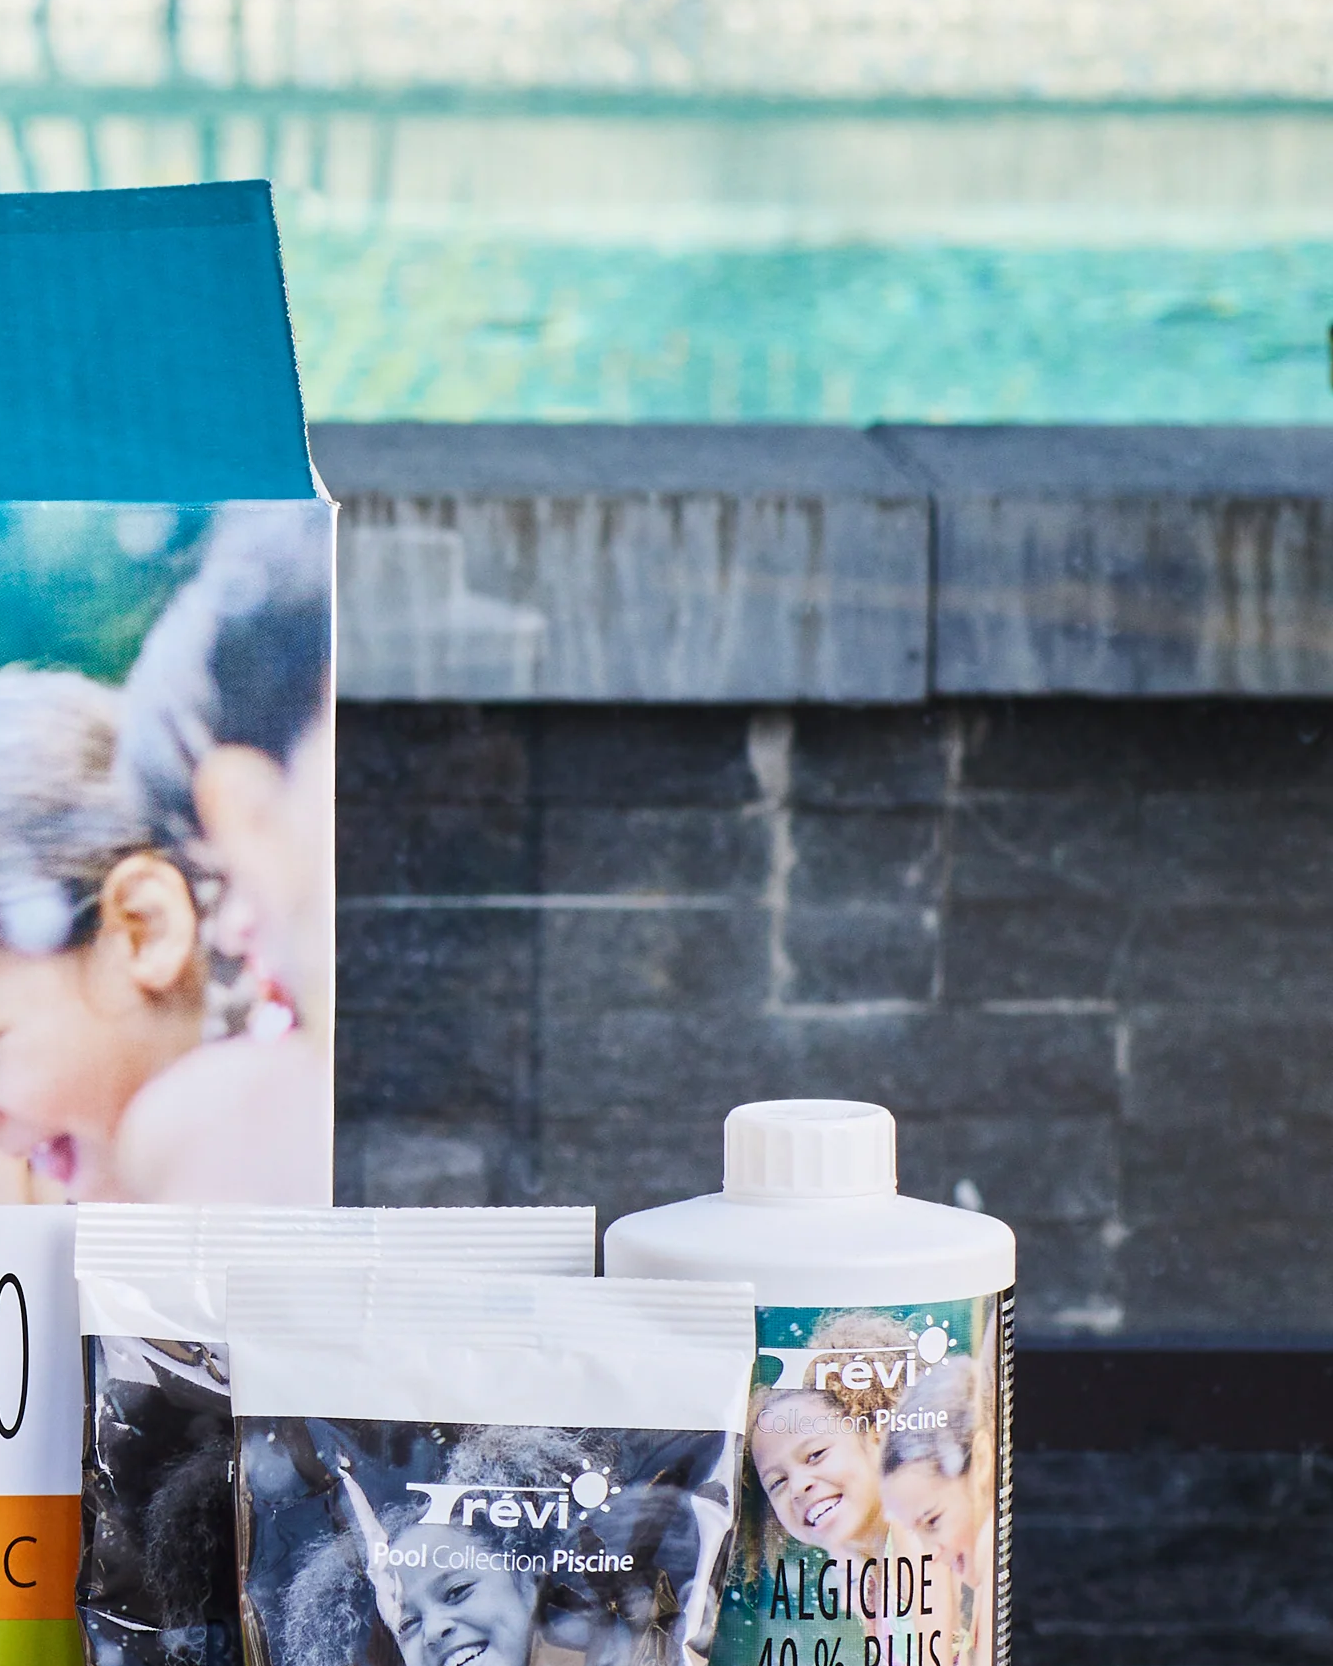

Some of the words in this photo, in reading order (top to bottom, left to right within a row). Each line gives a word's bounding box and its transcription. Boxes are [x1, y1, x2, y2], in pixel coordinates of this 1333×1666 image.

[759, 1346, 916, 1390] Trévi
[758, 1409, 869, 1433] Collection
[876, 1407, 948, 1432] Piscine
[406, 1483, 569, 1529] Trévi
[374, 1542, 426, 1567] Pool
[433, 1545, 545, 1572] Collection
[553, 1550, 633, 1573] Piscine
[770, 1554, 933, 1621] ALGICIDE
